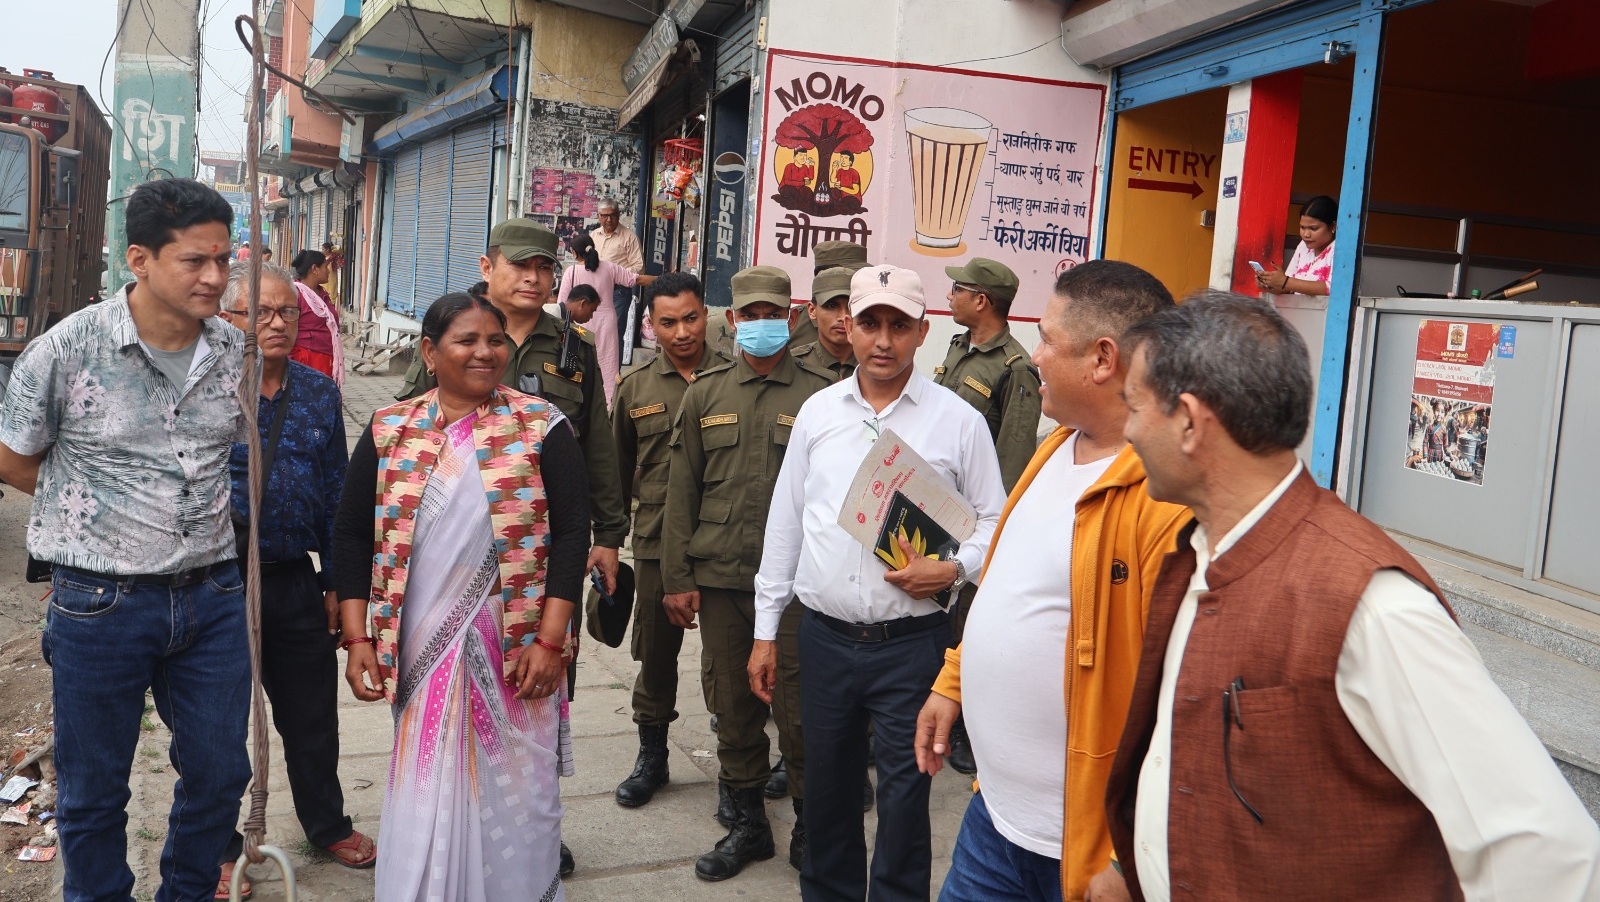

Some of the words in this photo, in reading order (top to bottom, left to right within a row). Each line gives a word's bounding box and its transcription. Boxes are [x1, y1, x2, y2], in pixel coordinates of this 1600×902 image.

[774, 72, 885, 121] MOMO
[1055, 140, 1077, 154] गफ
[1128, 145, 1216, 178] ENTRY
[1000, 163, 1028, 180] व्यापार
[1030, 163, 1044, 185] गर्नु
[1066, 170, 1085, 188] यार
[716, 187, 736, 262] PEPSI
[1060, 199, 1070, 216] यो
[1073, 202, 1087, 218] वर्ष
[653, 217, 668, 266] PEPS
[994, 219, 1025, 253] फेरी
[1024, 223, 1058, 254] अर्को
[1059, 227, 1088, 258] चिया
